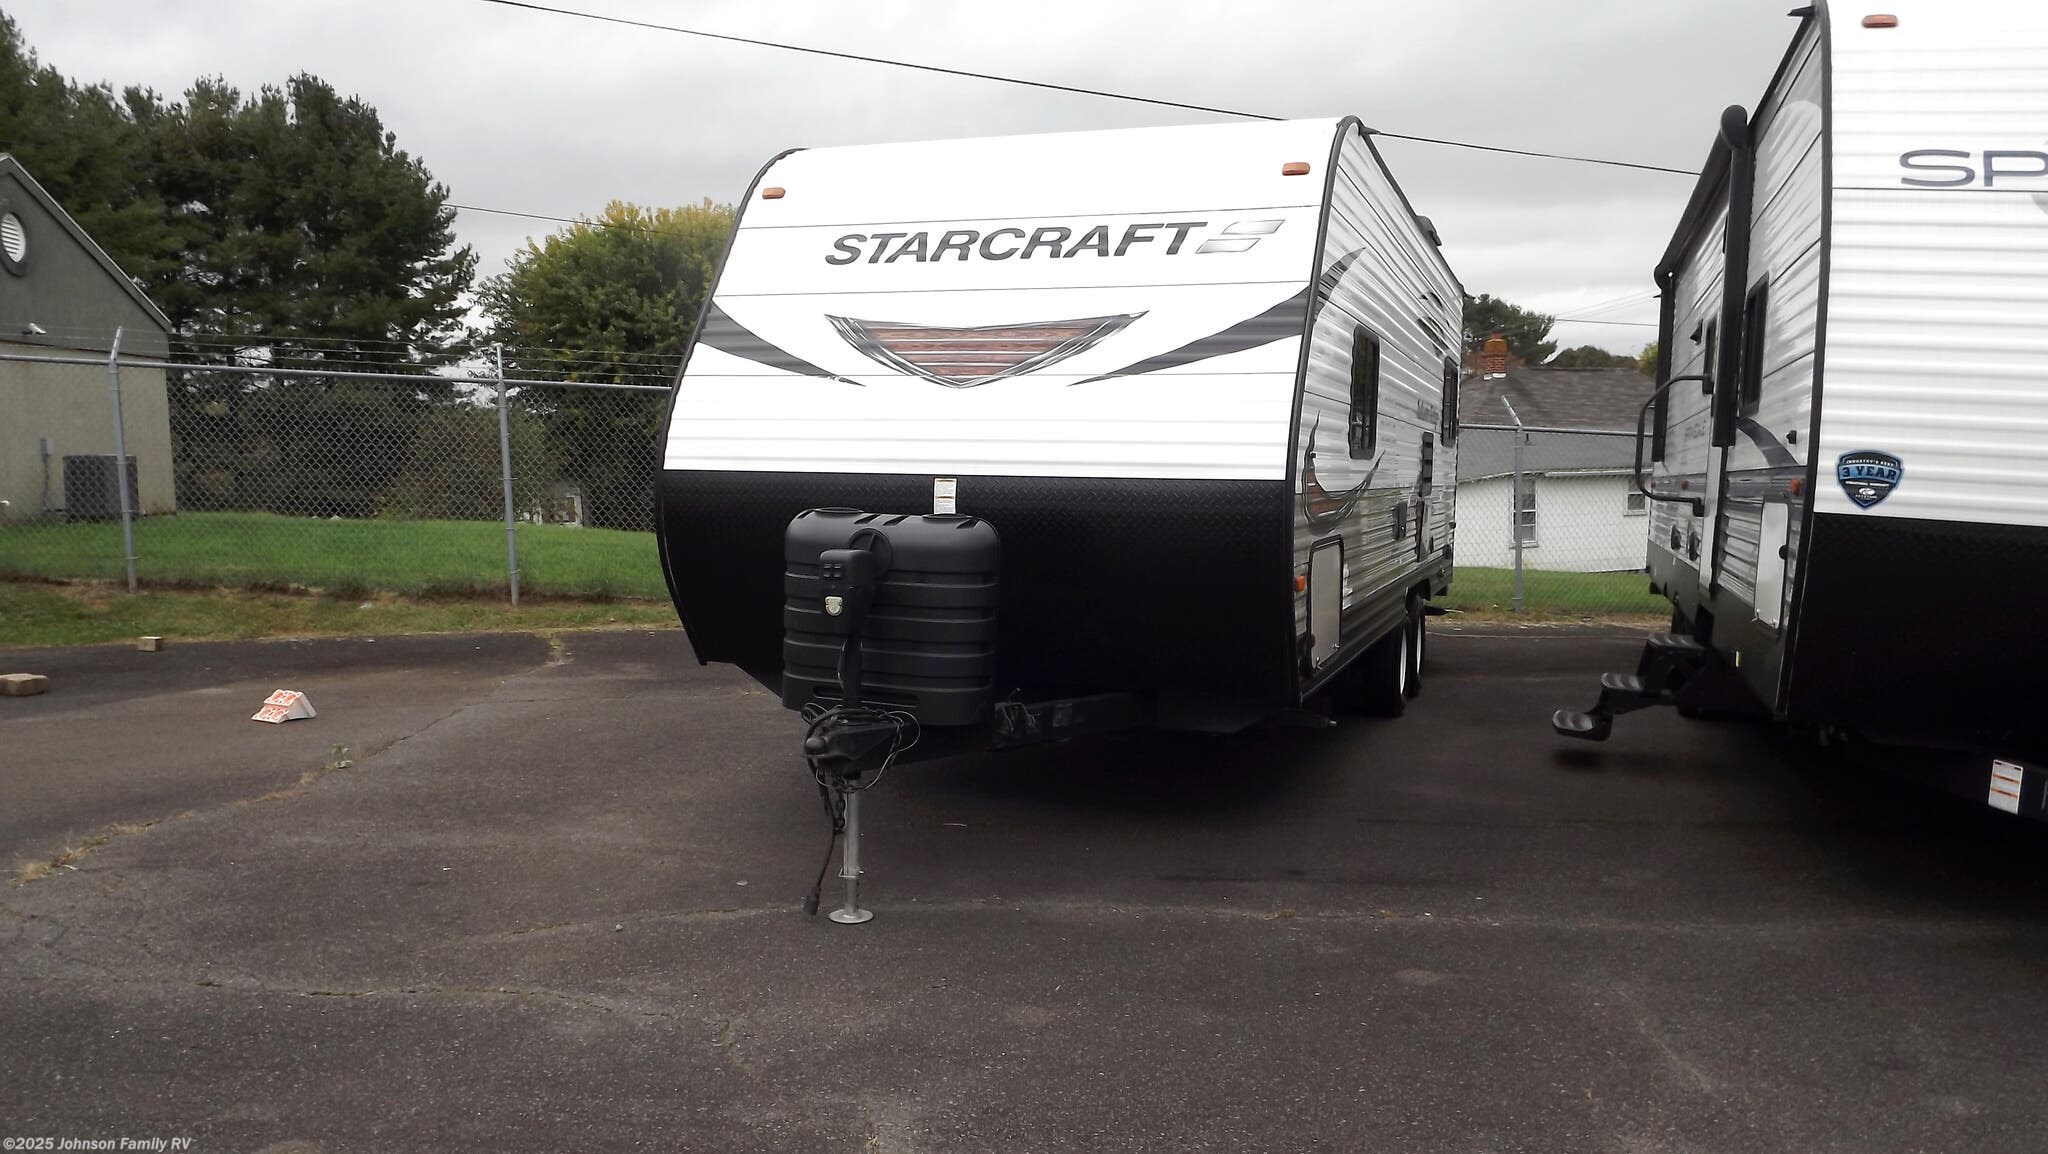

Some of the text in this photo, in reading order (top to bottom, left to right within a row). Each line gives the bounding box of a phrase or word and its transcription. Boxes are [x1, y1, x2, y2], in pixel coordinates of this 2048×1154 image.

[825, 221, 1207, 265] STARCRAFT
[1842, 466, 1897, 480] 3 YEAR
